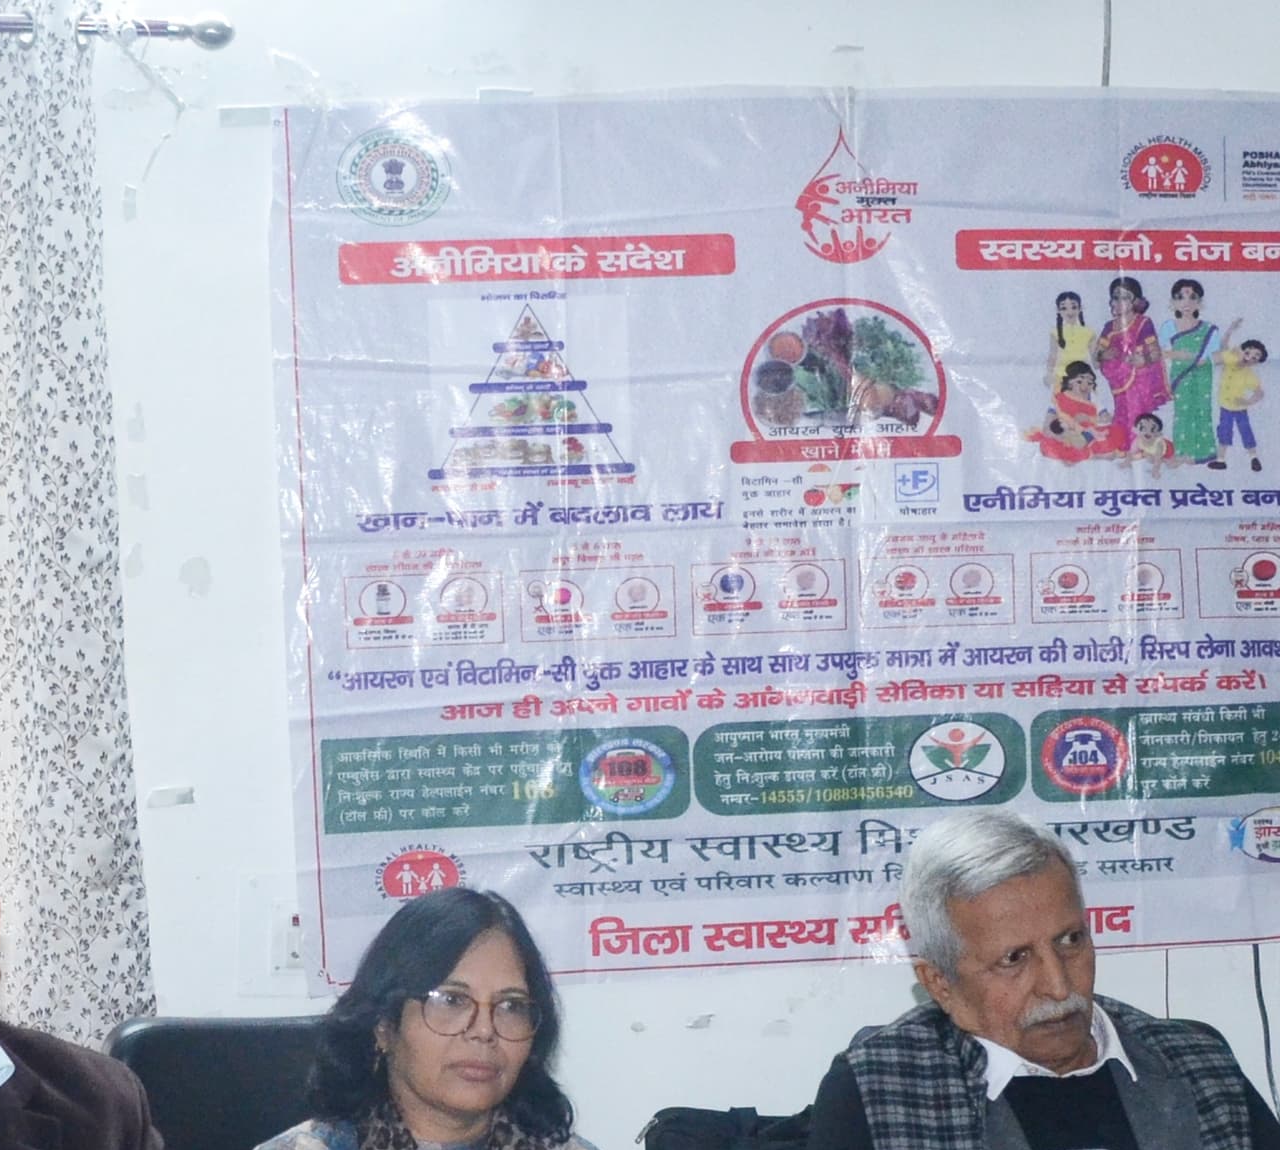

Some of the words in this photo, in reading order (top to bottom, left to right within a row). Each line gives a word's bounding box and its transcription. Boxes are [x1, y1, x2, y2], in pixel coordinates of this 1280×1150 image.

[1121, 141, 1147, 190] NATIONAL
[1148, 135, 1192, 150] HEALTH
[1193, 146, 1211, 192] MISSION
[835, 177, 918, 195] अनीमिया
[841, 208, 912, 224] भारत
[1093, 233, 1163, 263] बनो,
[1174, 234, 1232, 261] तेज
[551, 247, 586, 273] के
[597, 243, 686, 273] संदेश
[769, 425, 820, 437] आयरन
[877, 422, 919, 434] आहार
[801, 441, 840, 459] खाने
[741, 475, 778, 486] विटामिन
[764, 489, 791, 497] आहार
[963, 485, 1085, 512] एनीमिया
[1094, 488, 1162, 517] मुक्त
[1170, 483, 1233, 509] प्रदेश
[514, 501, 546, 527] में
[549, 504, 652, 527] बदलाव
[420, 662, 450, 689] एवं
[457, 658, 539, 686] विटामिन
[628, 659, 687, 680] आहार
[694, 650, 715, 677] के
[721, 656, 762, 677] साथ
[769, 653, 809, 674] साथ
[886, 648, 932, 669] मात्रा
[938, 641, 961, 667] में
[963, 646, 1033, 667] आयरन
[1039, 638, 1066, 664] की
[1140, 634, 1191, 660] सिरप
[1197, 632, 1235, 660] लेना
[441, 701, 504, 721] आज
[512, 694, 541, 718] ही
[626, 687, 692, 713] गावों
[697, 688, 726, 710] के
[876, 678, 966, 703] सेविका
[973, 682, 1005, 701] या
[1012, 674, 1094, 698] सहिया
[1102, 672, 1128, 696] से
[1216, 669, 1267, 692] करें।
[1219, 706, 1247, 721] किसी
[1251, 704, 1266, 720] भी
[438, 745, 447, 758] में
[453, 744, 481, 758] किसी
[490, 742, 503, 756] भी
[831, 745, 844, 760] की
[848, 742, 896, 758] जानकारी
[1069, 750, 1099, 764] 104
[488, 764, 503, 775] पर
[714, 770, 732, 789] हेतु
[821, 765, 839, 780] करें
[400, 808, 415, 819] पर
[400, 844, 445, 853] HEALTH
[526, 831, 670, 873] राष्ट्रीय
[686, 825, 841, 862] स्वास्थ्य
[554, 875, 643, 899] स्वास्थ्य
[652, 870, 687, 896] एवं
[695, 868, 775, 894] परिवार
[785, 868, 873, 889] कल्याण
[1096, 856, 1174, 877] सरकार
[590, 916, 692, 958] जिला
[704, 917, 839, 952] स्वास्थ्य
